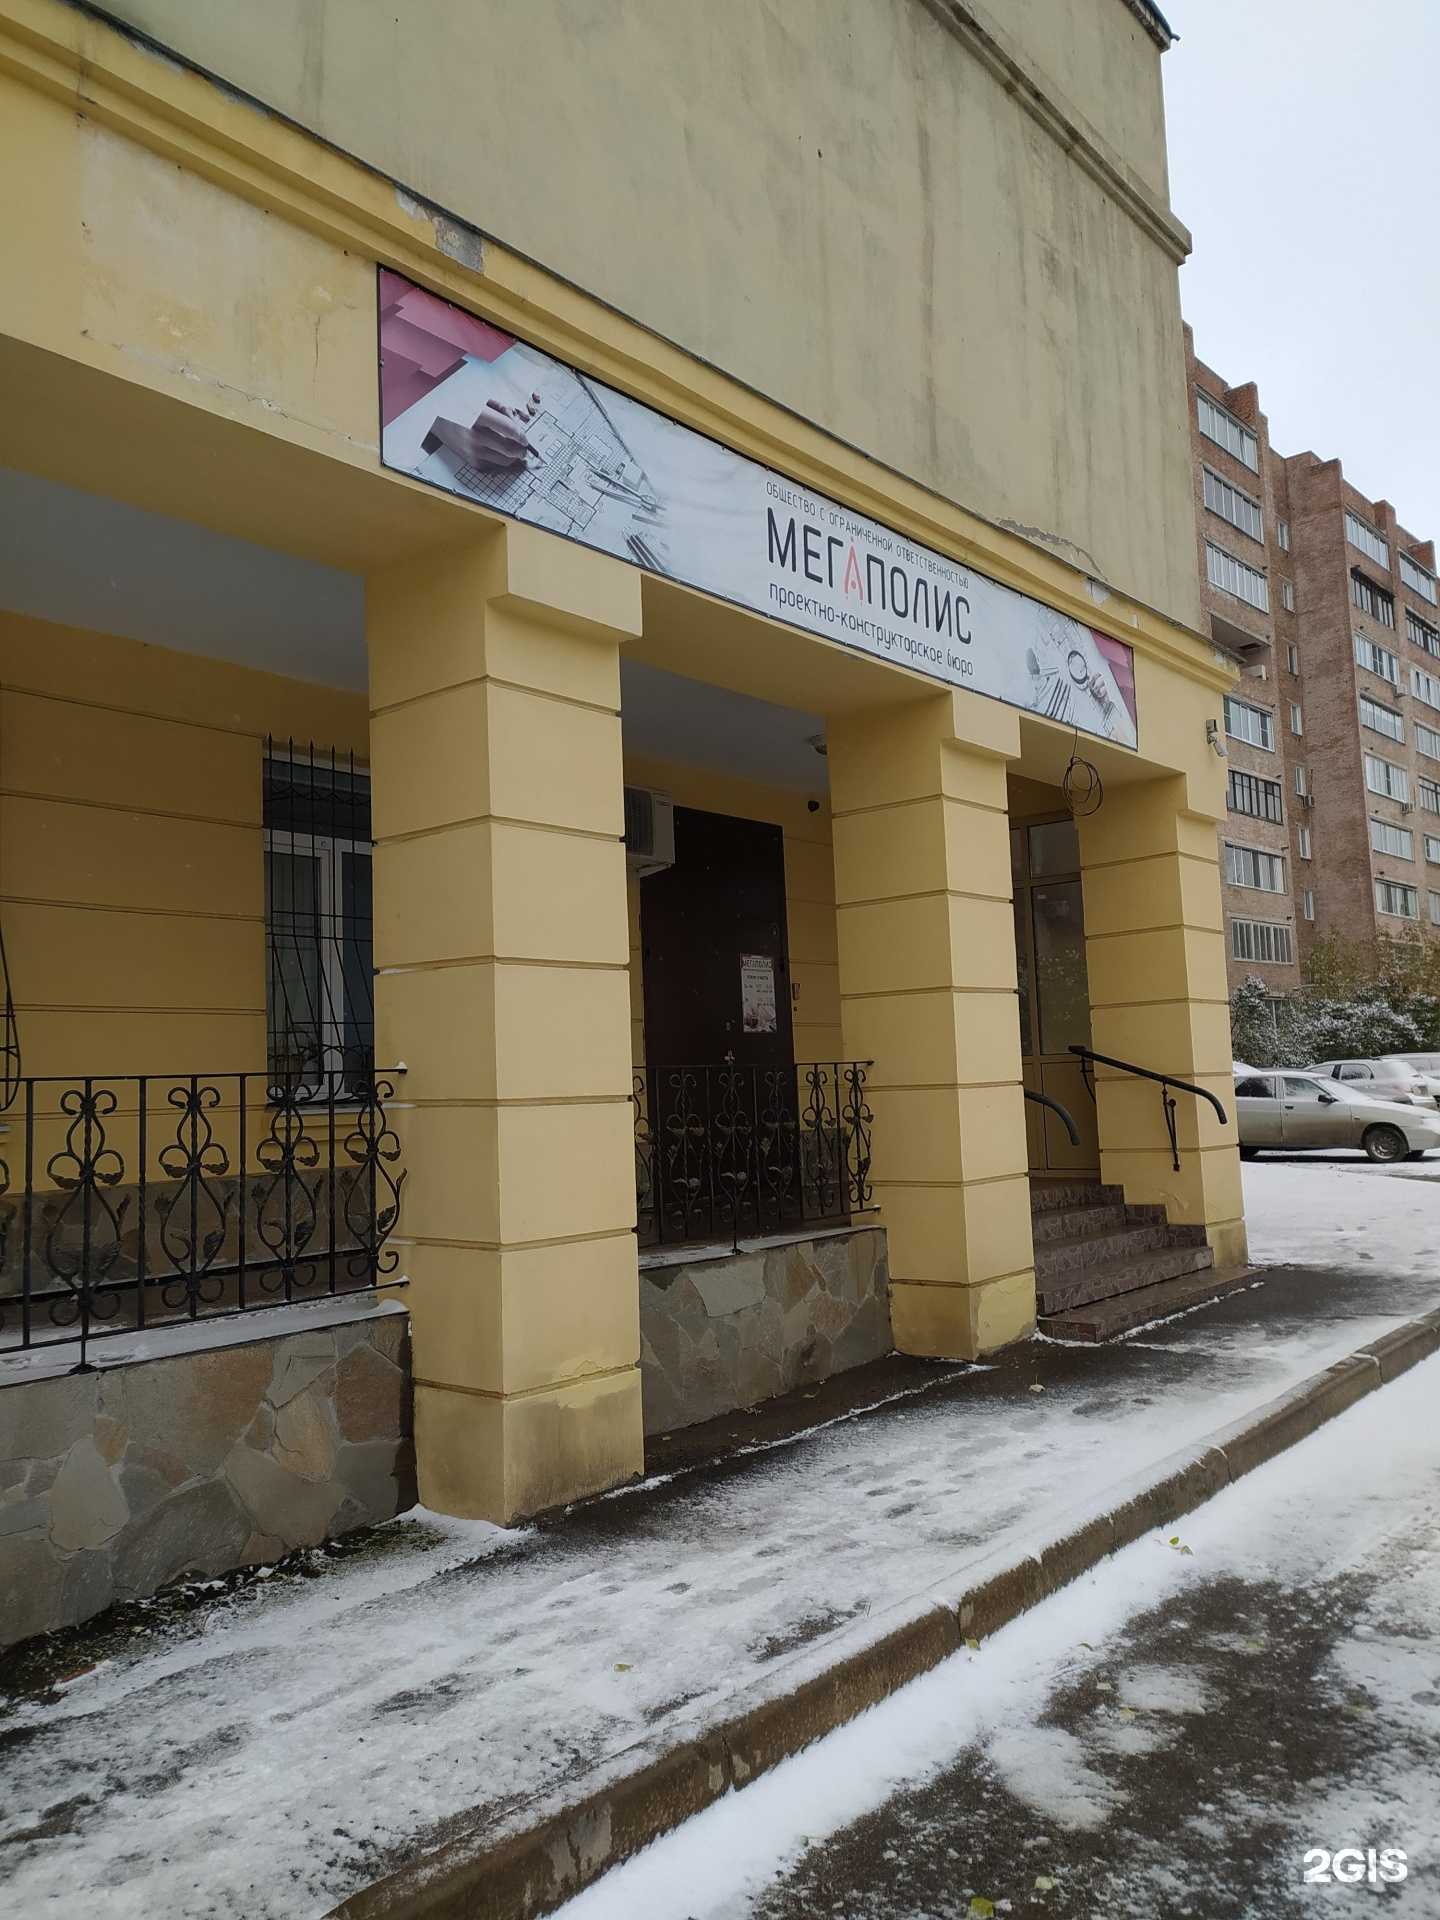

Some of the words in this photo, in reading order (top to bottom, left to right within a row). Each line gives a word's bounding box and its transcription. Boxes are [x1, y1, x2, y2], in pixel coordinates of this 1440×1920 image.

[766, 481, 816, 516] ОБЩЕСТВО
[819, 508, 825, 521] С
[829, 512, 893, 552] ОГРАНИЧЕННОЙ
[896, 545, 969, 589] ОТВЕТСТВЕННОСТЬЮ
[767, 507, 972, 644] МЕГАПОЛИС
[769, 583, 943, 664] проектно-конструкторское
[947, 649, 973, 677] бюро
